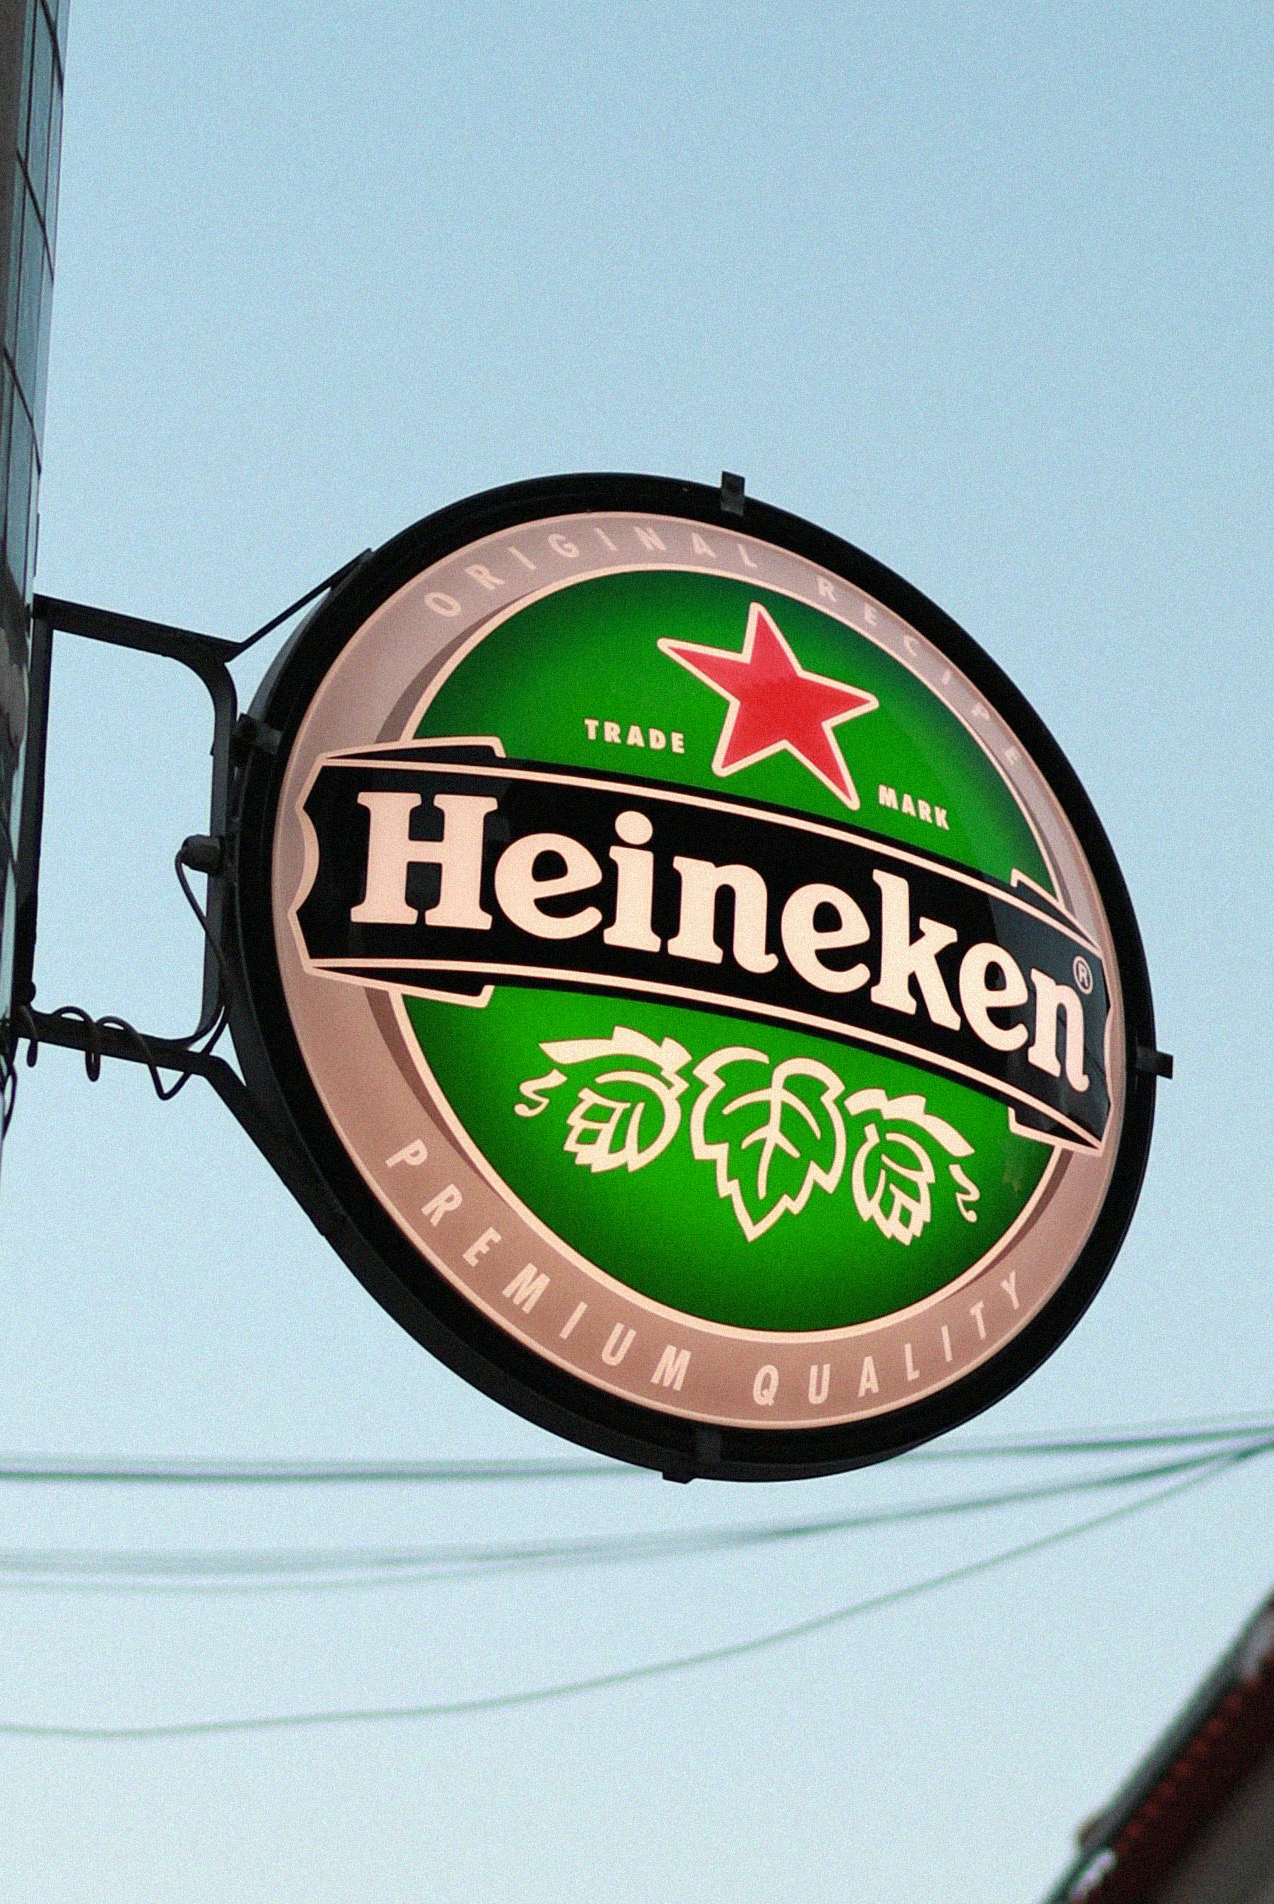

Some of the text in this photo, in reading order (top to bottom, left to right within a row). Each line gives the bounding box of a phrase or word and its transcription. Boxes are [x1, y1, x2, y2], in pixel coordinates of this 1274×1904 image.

[424, 526, 1022, 765] ORIGINAL RECIPE
[584, 718, 950, 831] TRADE MARK
[349, 791, 1090, 1093] Heineken
[385, 1138, 1020, 1406] PREMIUM QUALITY
